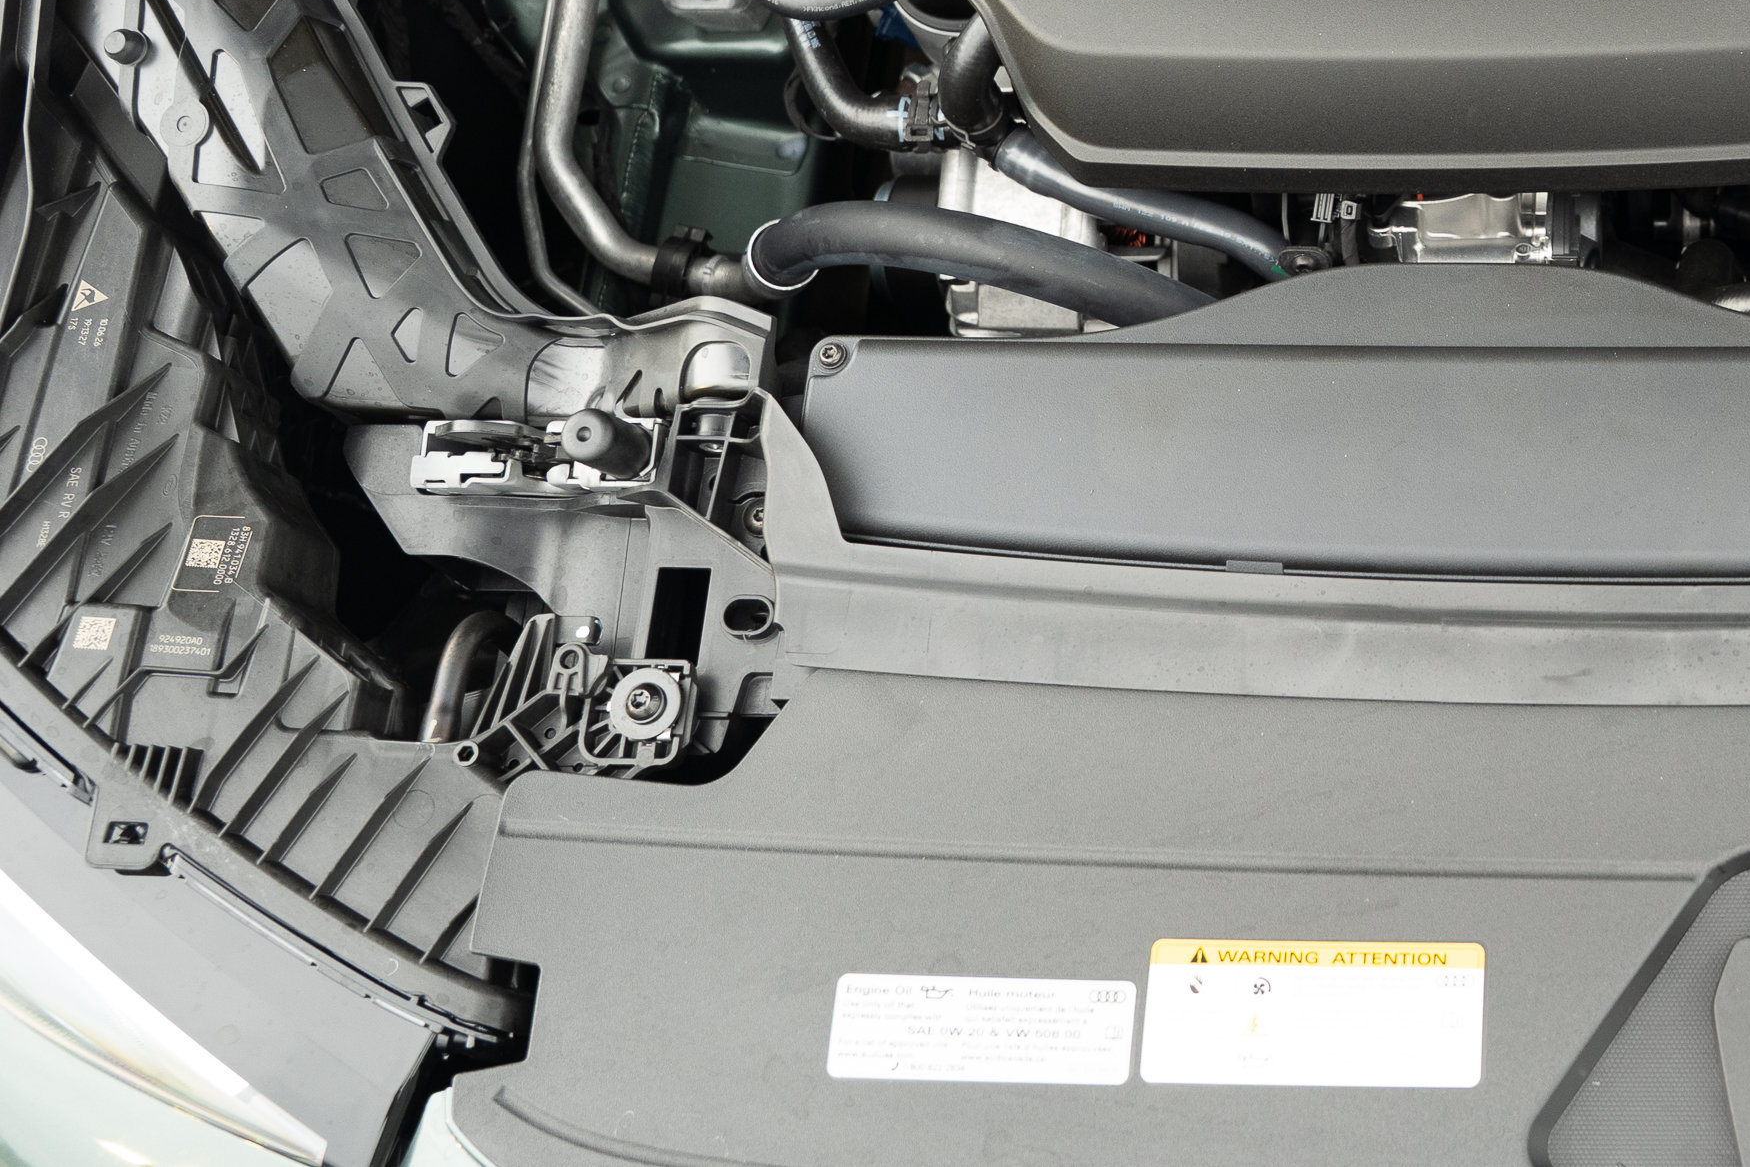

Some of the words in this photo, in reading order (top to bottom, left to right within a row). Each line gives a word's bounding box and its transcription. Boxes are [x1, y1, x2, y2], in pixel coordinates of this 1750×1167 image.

[66, 466, 82, 487] SAE
[1217, 949, 1320, 965] WARNING
[1331, 950, 1448, 966] ATTENTION
[846, 985, 890, 997] Engine
[895, 985, 913, 995] Oil
[968, 988, 1002, 998] Huile
[1006, 989, 1056, 999] moteur
[907, 1026, 934, 1036] SAE
[990, 1028, 999, 1037] &
[1006, 1029, 1030, 1038] VW
[1064, 1030, 1081, 1039] 00
